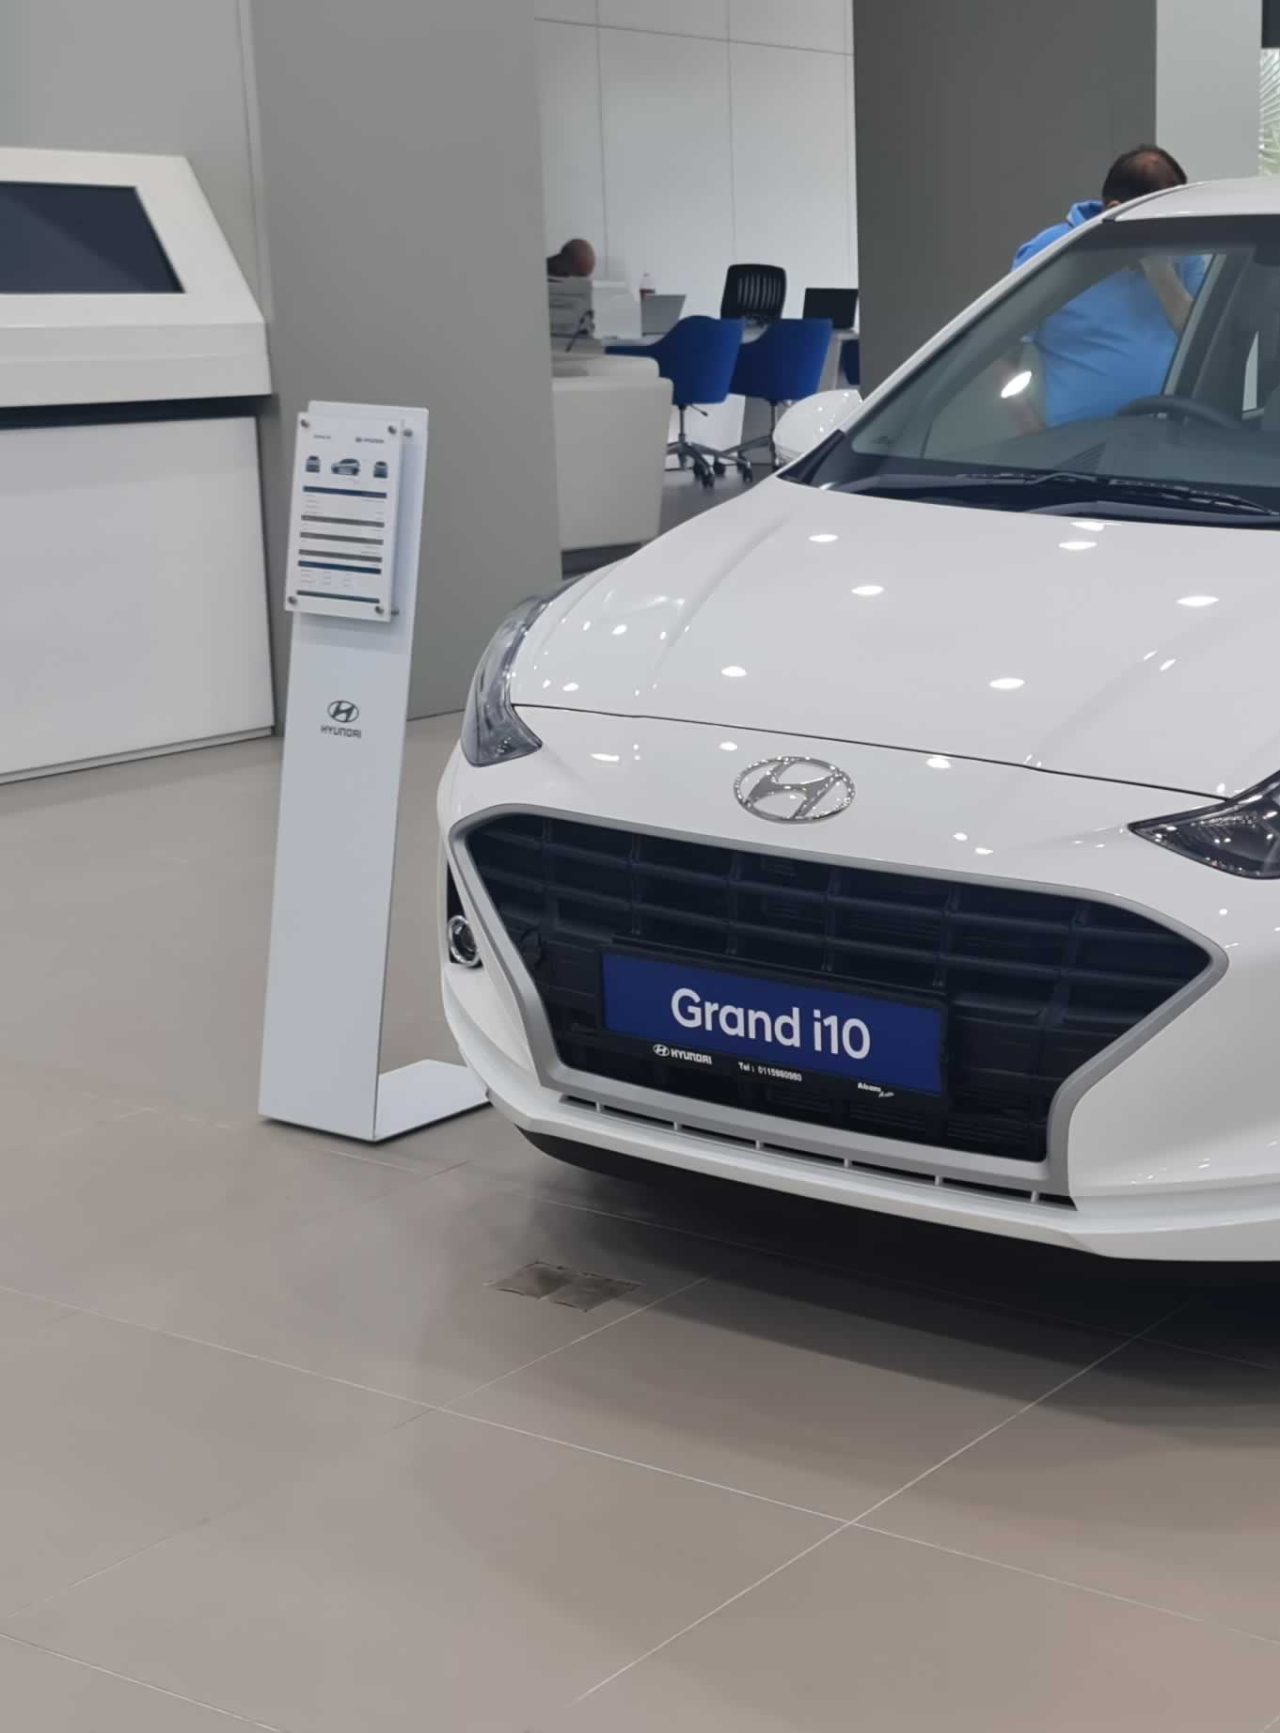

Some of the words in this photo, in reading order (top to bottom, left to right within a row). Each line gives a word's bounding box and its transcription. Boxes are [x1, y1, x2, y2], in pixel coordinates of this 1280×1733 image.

[320, 725, 362, 740] HYUNDAI
[671, 987, 801, 1048] Grand
[813, 1009, 871, 1060] i10
[670, 1048, 712, 1065] HYUNDAI
